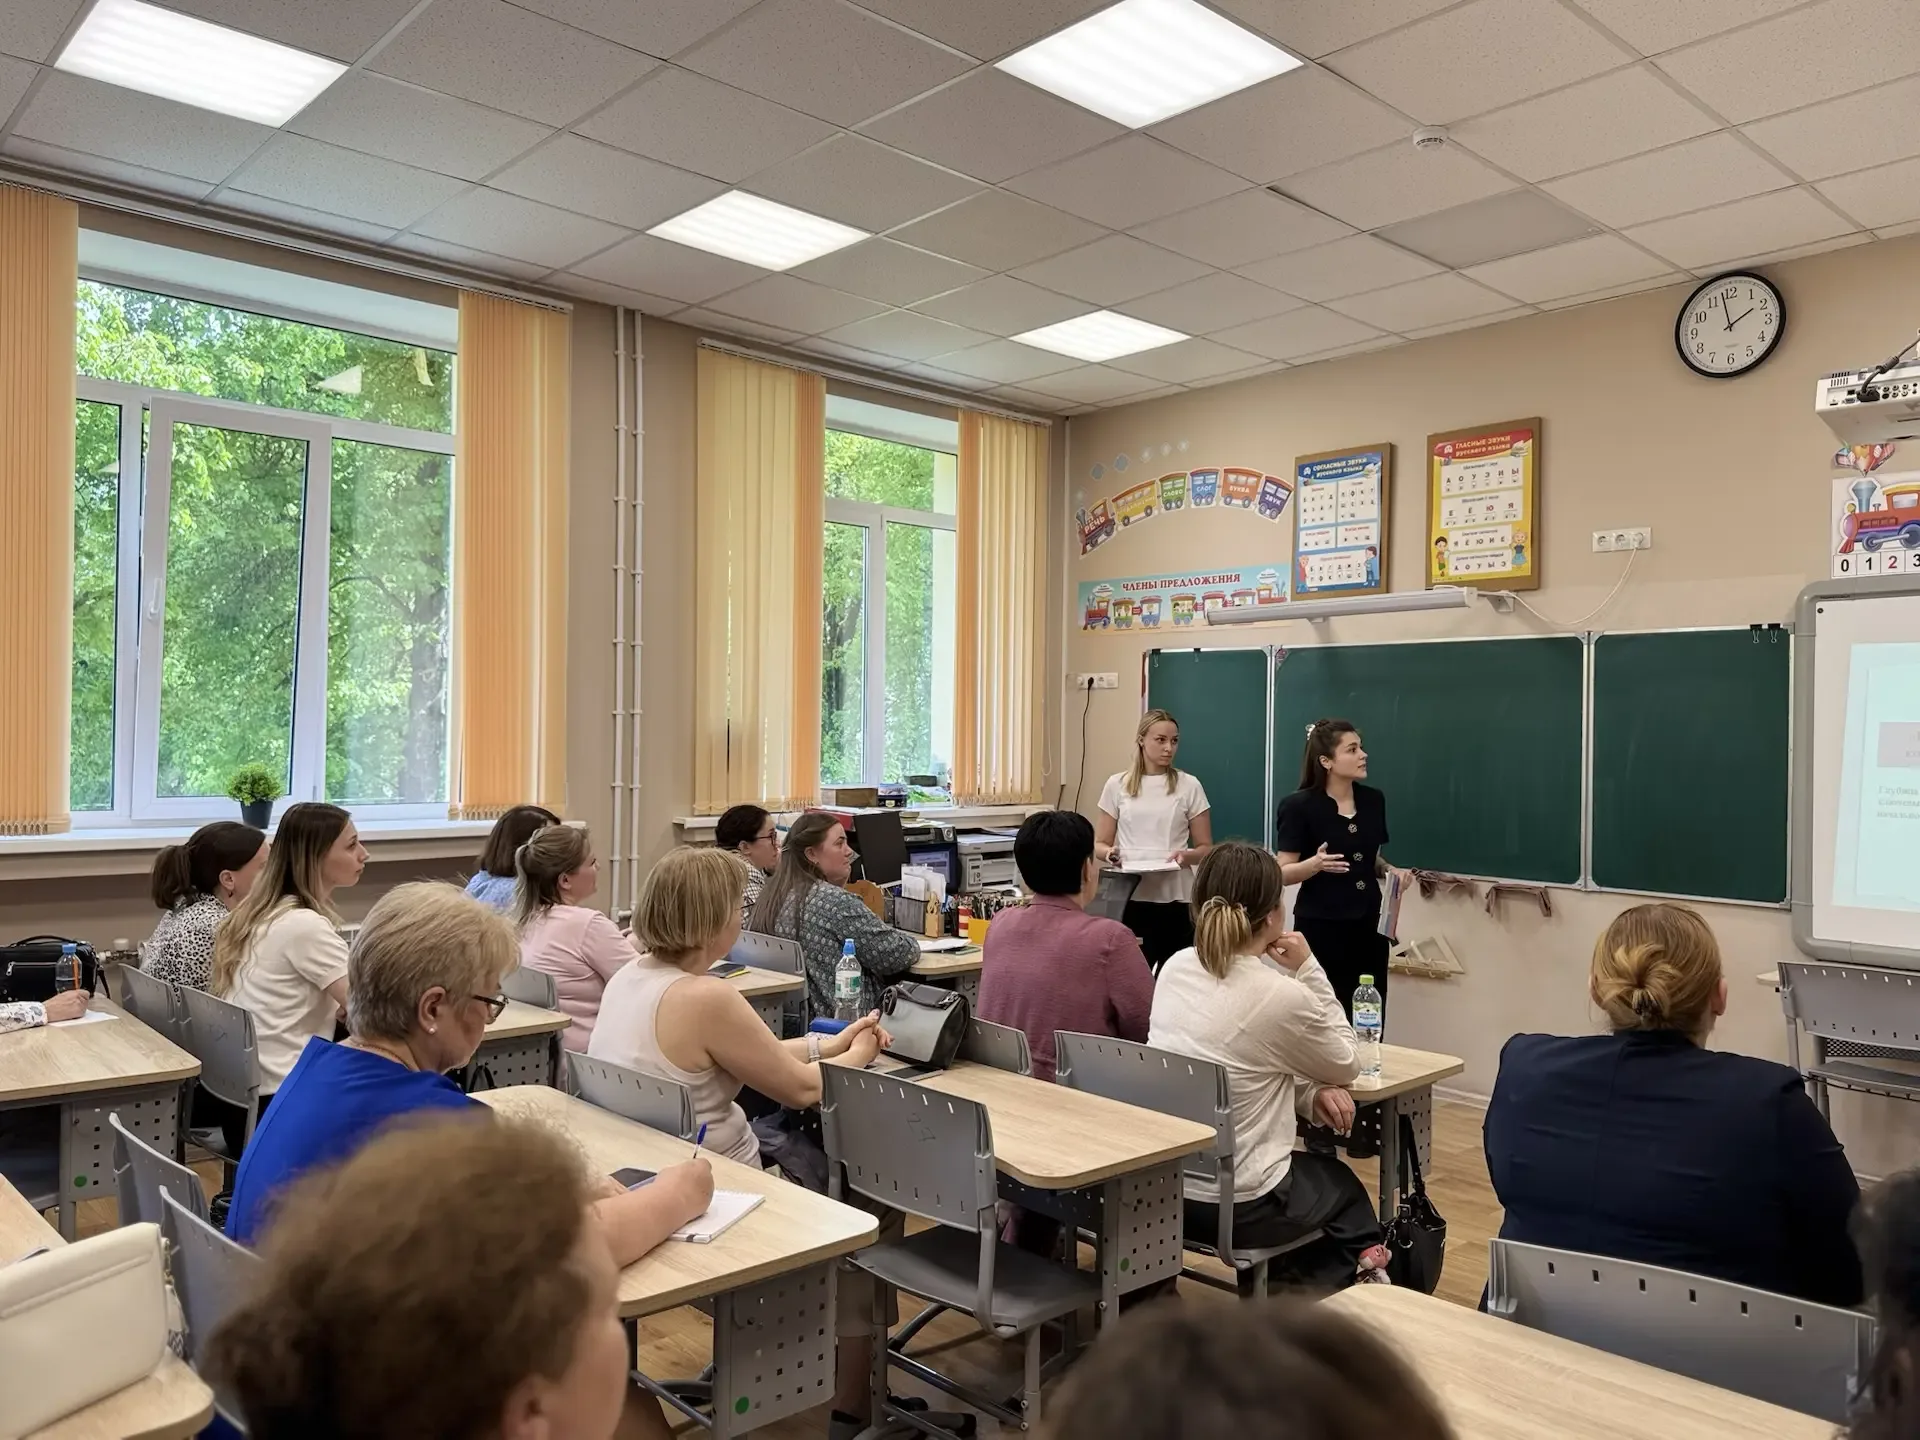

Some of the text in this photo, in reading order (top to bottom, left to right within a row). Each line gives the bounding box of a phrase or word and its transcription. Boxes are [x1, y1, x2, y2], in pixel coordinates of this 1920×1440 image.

[1725, 286, 1738, 300] 12
[1748, 288, 1754, 300] 1
[1708, 296, 1719, 309] 11
[1760, 298, 1767, 310] 2
[1694, 310, 1707, 324] 10
[1764, 313, 1773, 325] 3
[1690, 327, 1698, 340] 9
[1757, 330, 1766, 342] 4
[1696, 342, 1704, 354] 8
[1746, 345, 1754, 357] 5
[1709, 351, 1716, 364] 7
[1727, 353, 1735, 365] 6
[1455, 435, 1511, 449] ГЛАСНЫЕ ЗВУКИ
[1162, 488, 1183, 498] СЛОВО
[1196, 485, 1212, 493] СЛОГ
[1229, 485, 1250, 494] БУКВА
[1264, 493, 1282, 505] ЗВУК
[1084, 515, 1105, 534] РЕЧЬ
[1840, 558, 1850, 572] 0
[1865, 557, 1872, 570] 1
[1888, 555, 1898, 569] 2
[1912, 553, 1920, 567] 3
[1122, 581, 1158, 592] ЧЛЕНЫ
[1160, 573, 1241, 589] ПРЕДЛОЖЕНИЯ
